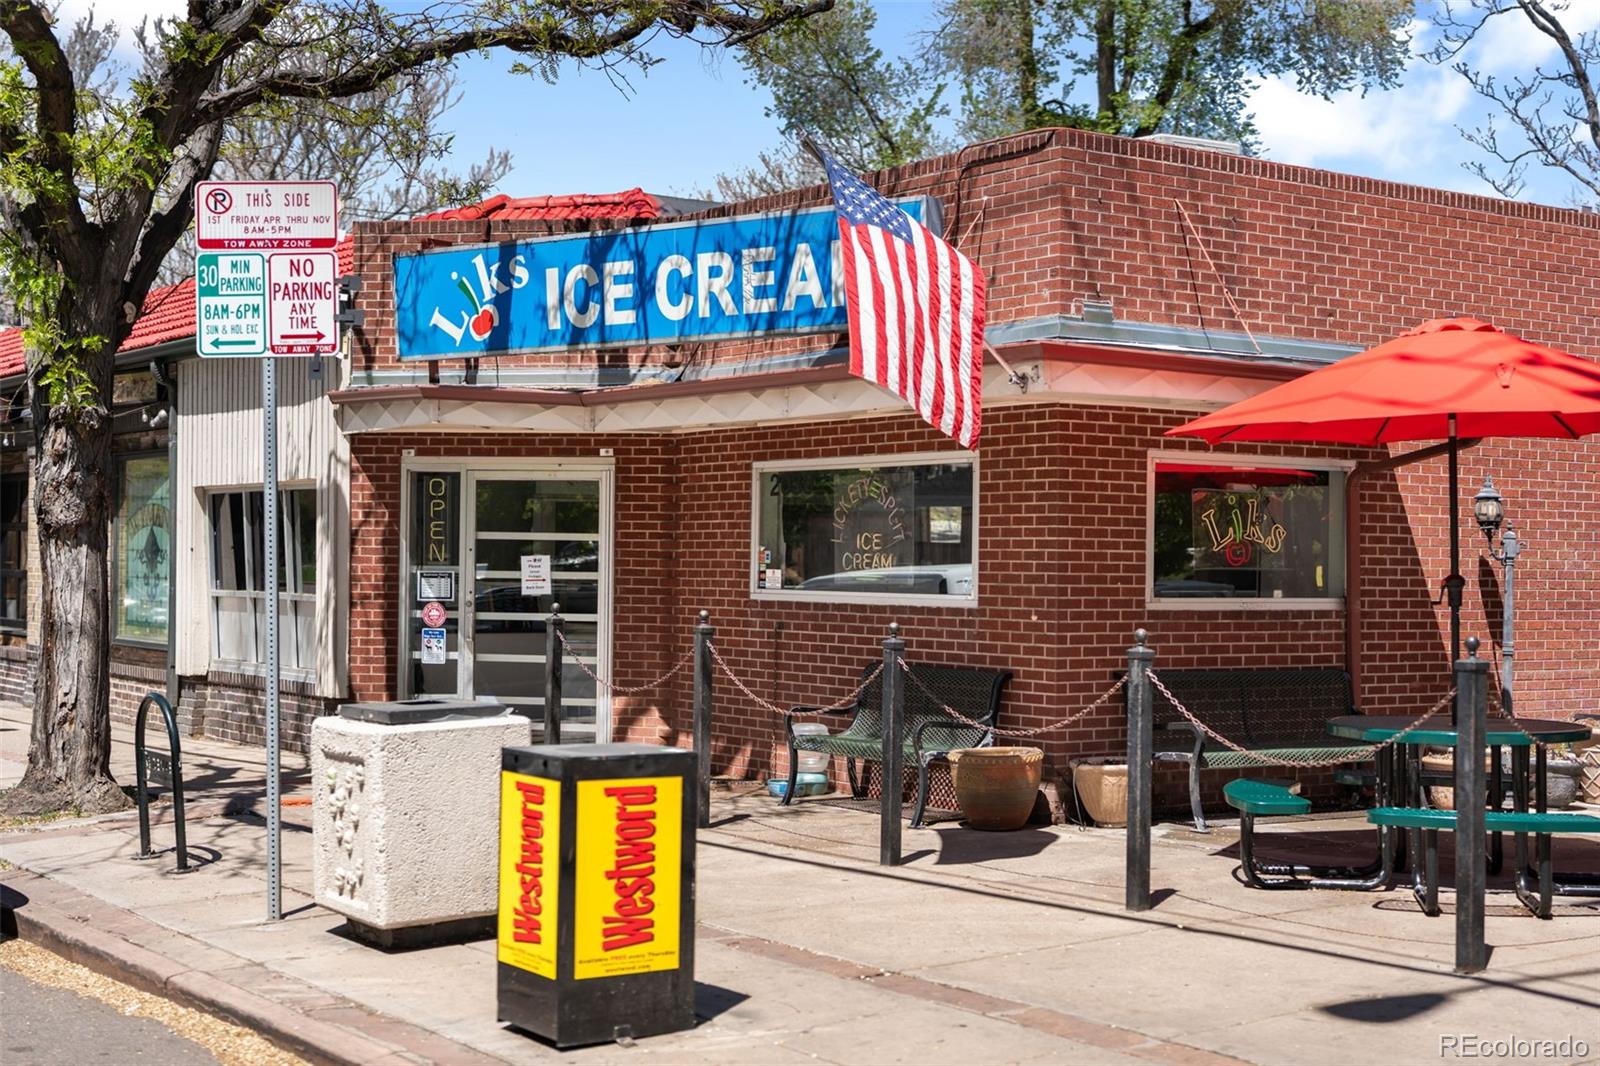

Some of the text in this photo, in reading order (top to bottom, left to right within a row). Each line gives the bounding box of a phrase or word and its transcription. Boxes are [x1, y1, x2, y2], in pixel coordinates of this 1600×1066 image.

[246, 193, 311, 208] THIS SIDE
[207, 216, 331, 225] 1ST FRIDAY APR THRU NOV
[223, 239, 312, 248] TOW AWAY ZONE
[230, 260, 250, 274] MIN
[289, 258, 315, 278] NO
[200, 265, 218, 287] 30
[220, 277, 262, 292] PARKING
[273, 282, 332, 301] PARKING
[546, 260, 637, 330] ICE
[204, 303, 261, 320] 8AM-6PM
[290, 303, 316, 315] ANY
[205, 325, 219, 335] SUN
[230, 324, 244, 335] HOL
[246, 324, 259, 334] EXC
[288, 316, 318, 330] TIME
[292, 345, 310, 353] AWAY
[428, 478, 446, 562] OPEN
[856, 532, 882, 550] ICE
[842, 552, 894, 571] CREAM
[513, 781, 545, 944] Westword
[602, 785, 658, 952] Westword
